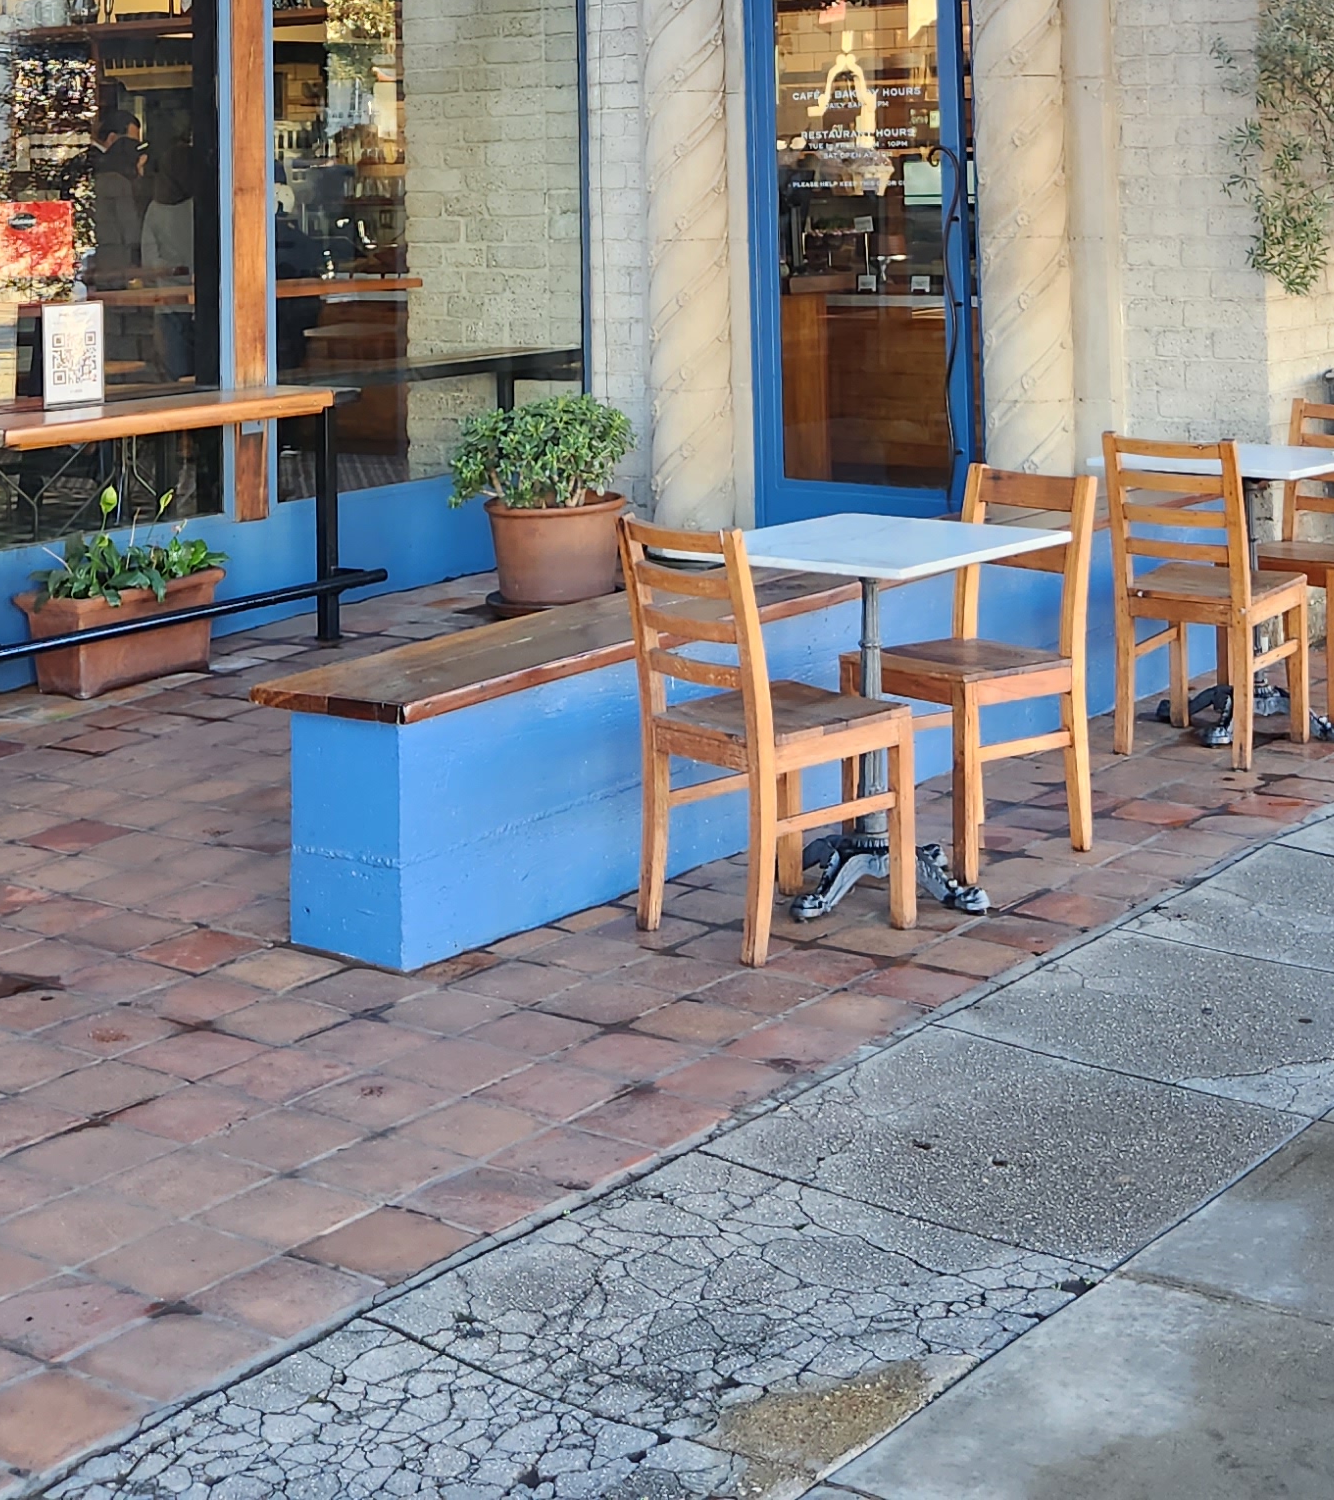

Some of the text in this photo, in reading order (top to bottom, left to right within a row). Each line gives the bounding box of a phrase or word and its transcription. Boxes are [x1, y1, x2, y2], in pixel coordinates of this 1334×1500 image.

[882, 86, 922, 97] HOURS
[875, 127, 916, 138] HOURS
[807, 142, 824, 150] TUE
[887, 140, 909, 148] 10PM
